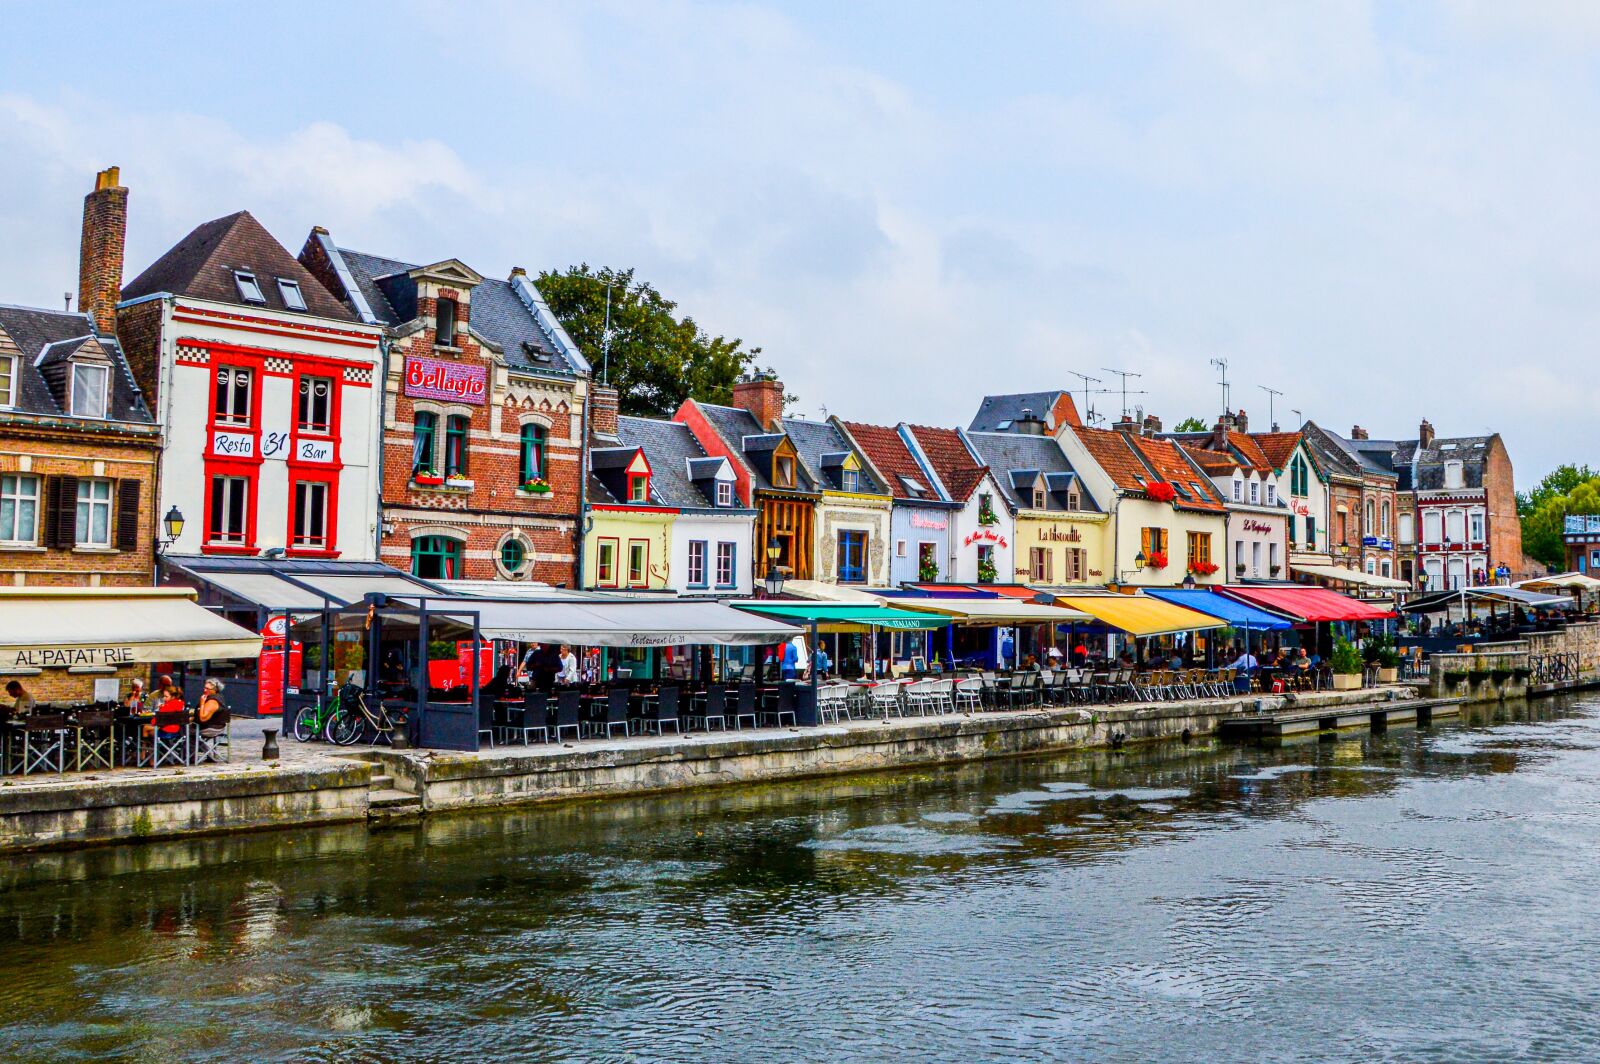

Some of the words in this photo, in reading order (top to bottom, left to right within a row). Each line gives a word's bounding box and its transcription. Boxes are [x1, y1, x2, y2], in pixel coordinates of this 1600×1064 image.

[407, 361, 484, 397] Bellagio
[215, 435, 251, 453] Resto
[264, 432, 288, 456] 31
[302, 443, 327, 459] Bar
[1039, 527, 1048, 541] La
[1088, 568, 1103, 577] Resto
[893, 620, 920, 628] ITALIANO
[631, 633, 667, 645] Restaurant
